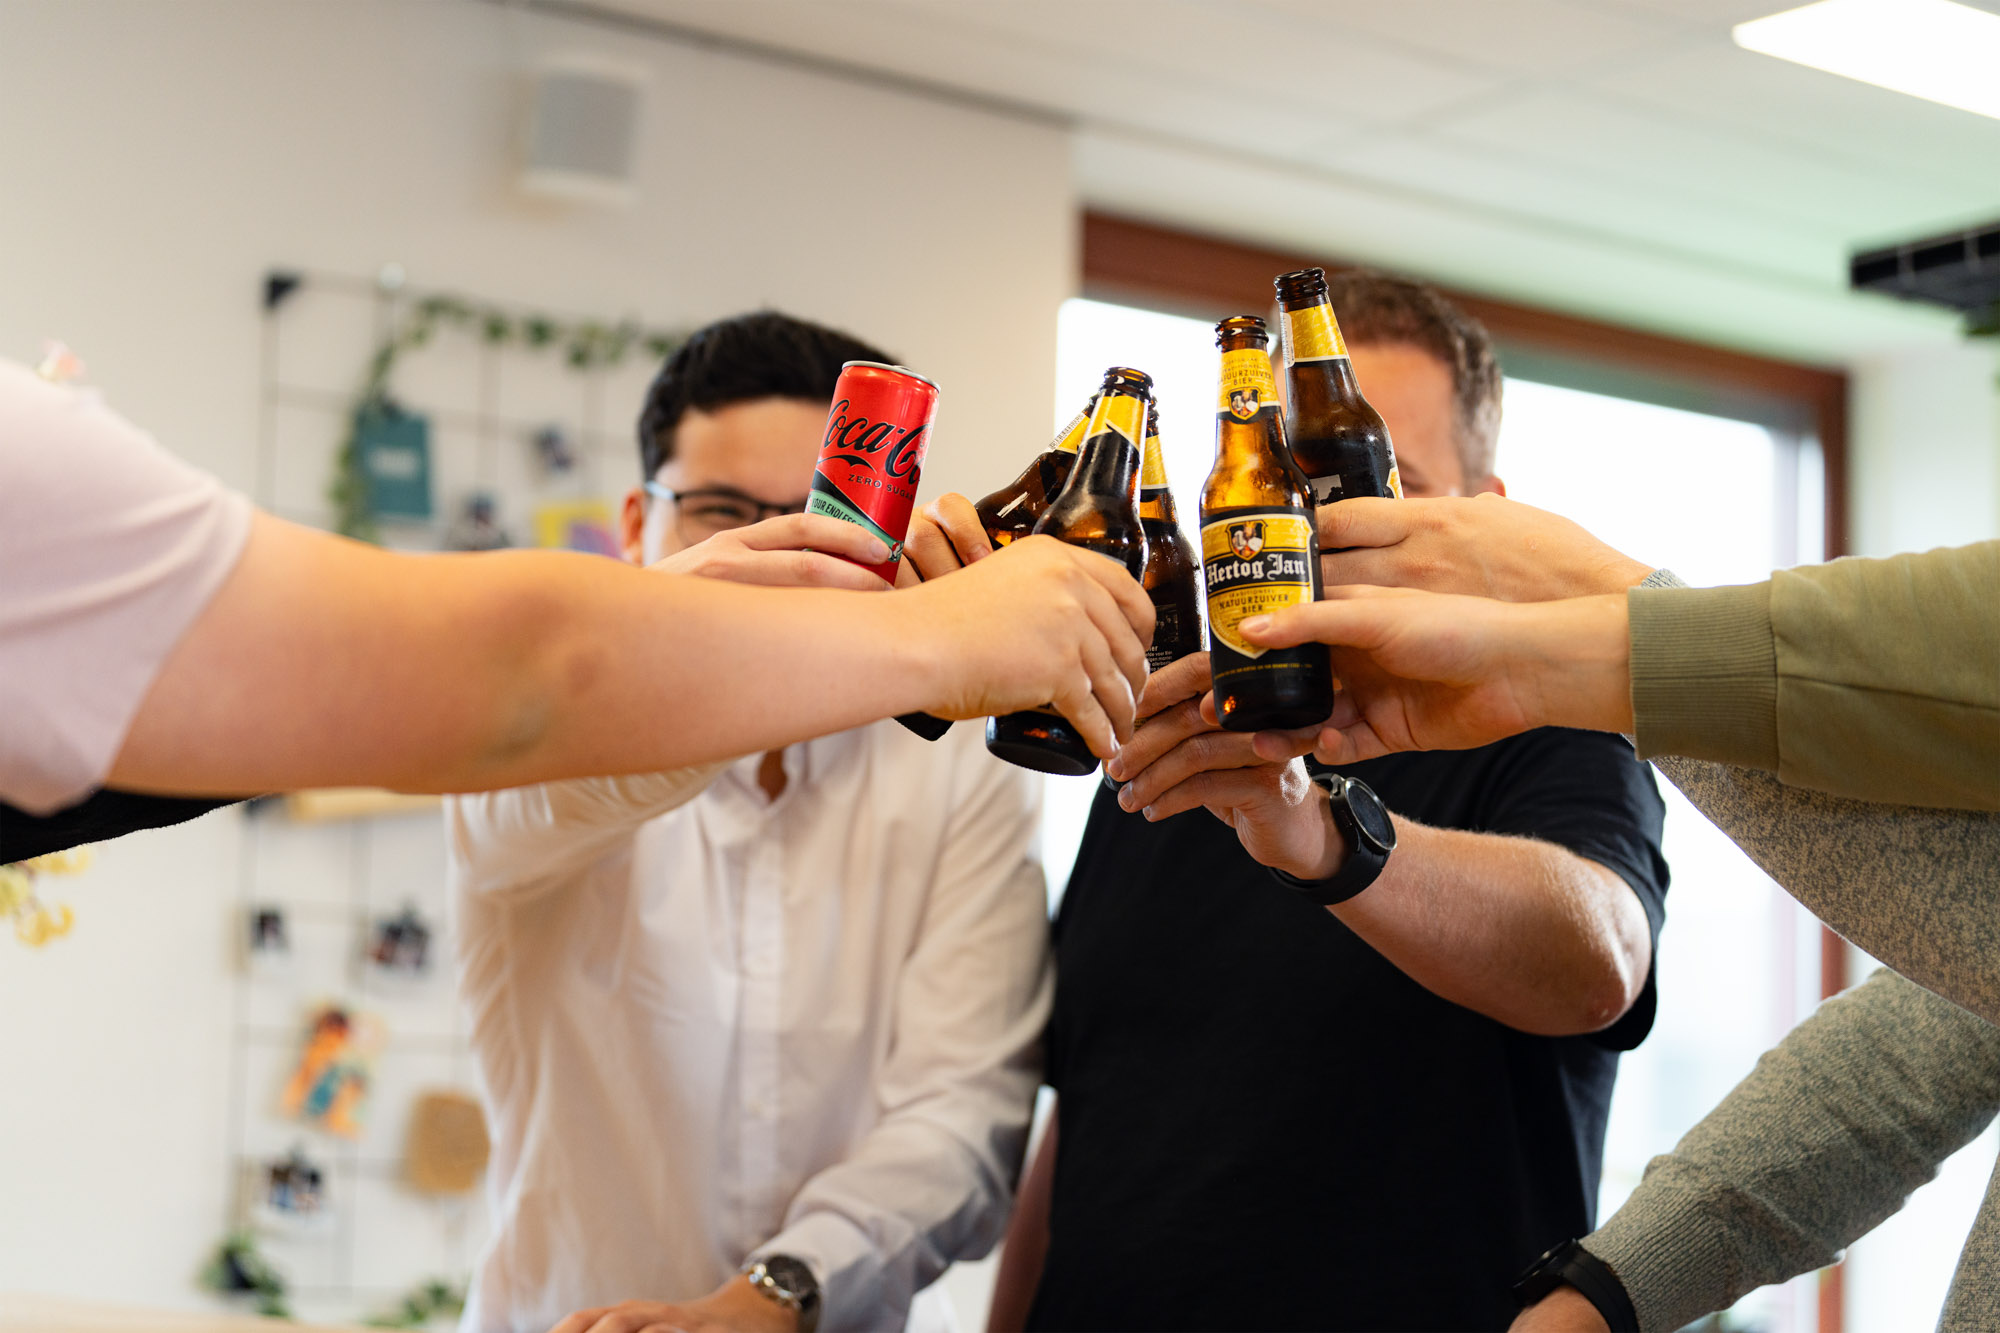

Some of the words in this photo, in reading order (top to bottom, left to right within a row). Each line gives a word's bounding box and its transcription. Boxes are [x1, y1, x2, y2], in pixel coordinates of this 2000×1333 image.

[1233, 377, 1253, 386] BIER
[847, 473, 883, 489] ZERO
[1206, 560, 1265, 592] Hertog
[1266, 553, 1306, 580] Jan
[1219, 594, 1289, 610] NATUURZUIVER
[1242, 604, 1263, 614] BIER
